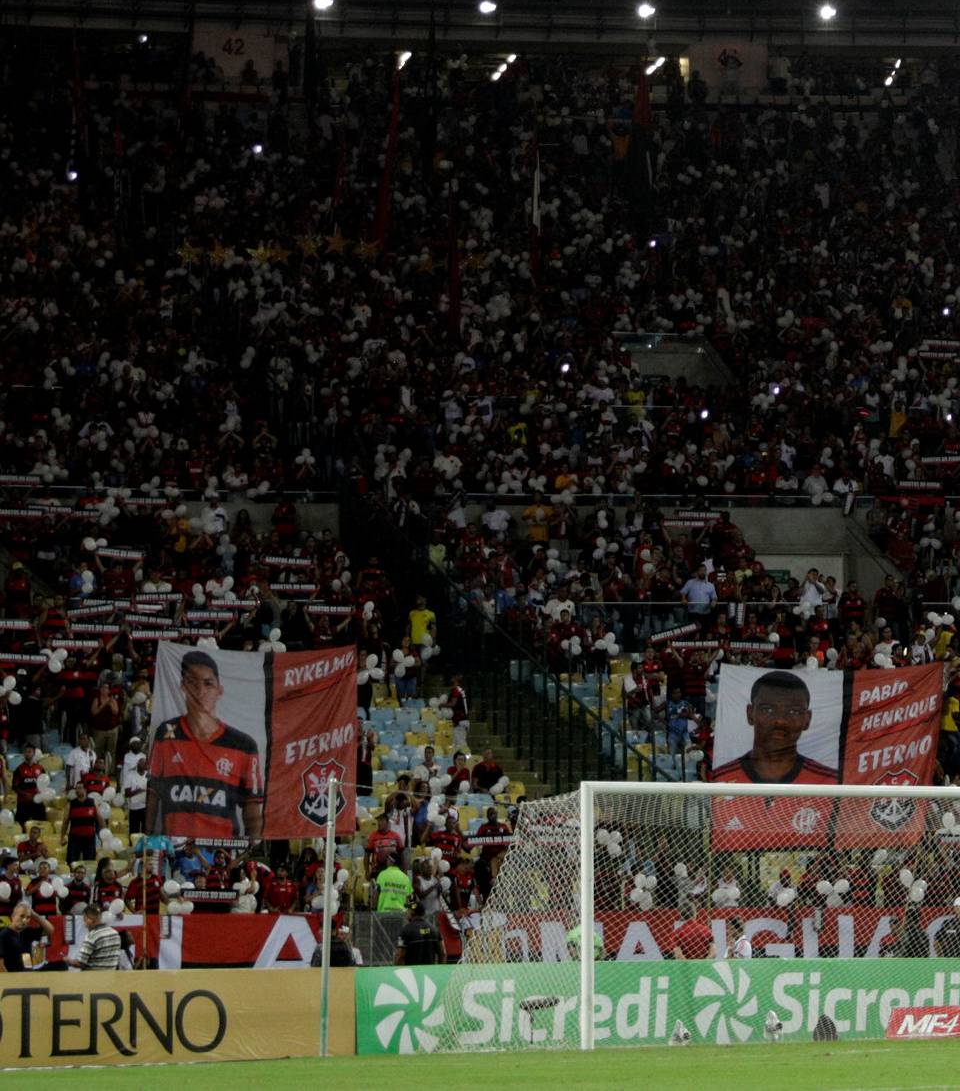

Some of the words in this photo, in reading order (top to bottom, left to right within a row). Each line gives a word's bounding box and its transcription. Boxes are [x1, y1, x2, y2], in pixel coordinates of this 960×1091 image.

[222, 38, 245, 55] 42
[861, 694, 938, 732] HENRIQUE
[285, 722, 355, 765] ETERNO
[857, 734, 933, 773] ETERNO
[170, 785, 228, 808] CAIXA
[0, 986, 227, 1057] TERNO
[457, 976, 669, 1047] Sicredi
[772, 972, 960, 1037] Sicredi
[896, 1013, 960, 1036] MF4
